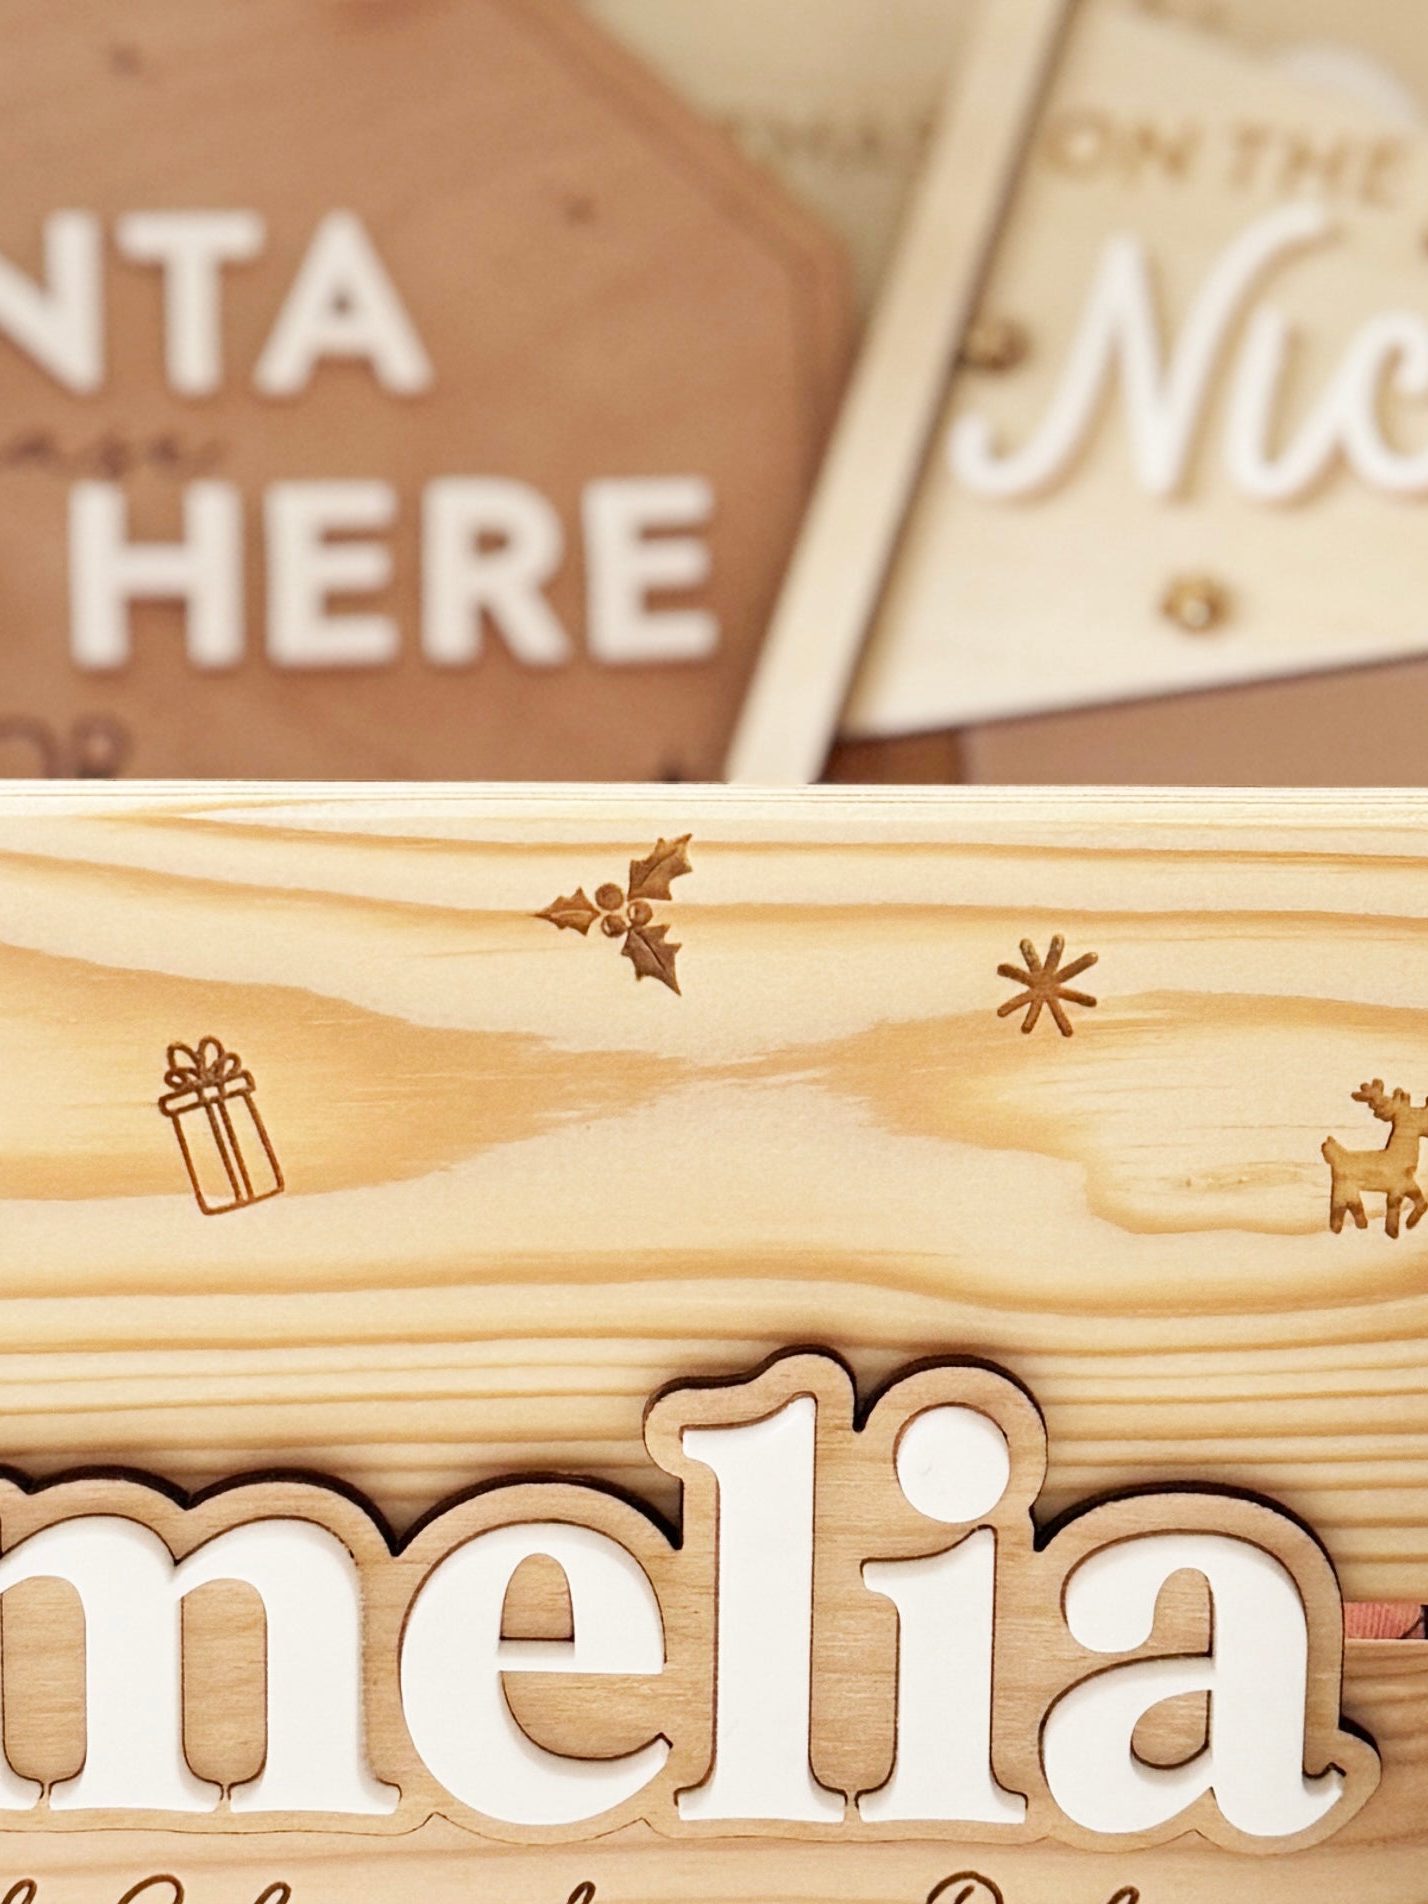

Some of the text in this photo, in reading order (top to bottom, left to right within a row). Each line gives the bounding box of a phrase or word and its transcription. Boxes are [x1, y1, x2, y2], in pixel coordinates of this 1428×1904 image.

[1034, 108, 1412, 208] ON THE
[70, 474, 723, 670] HERE
